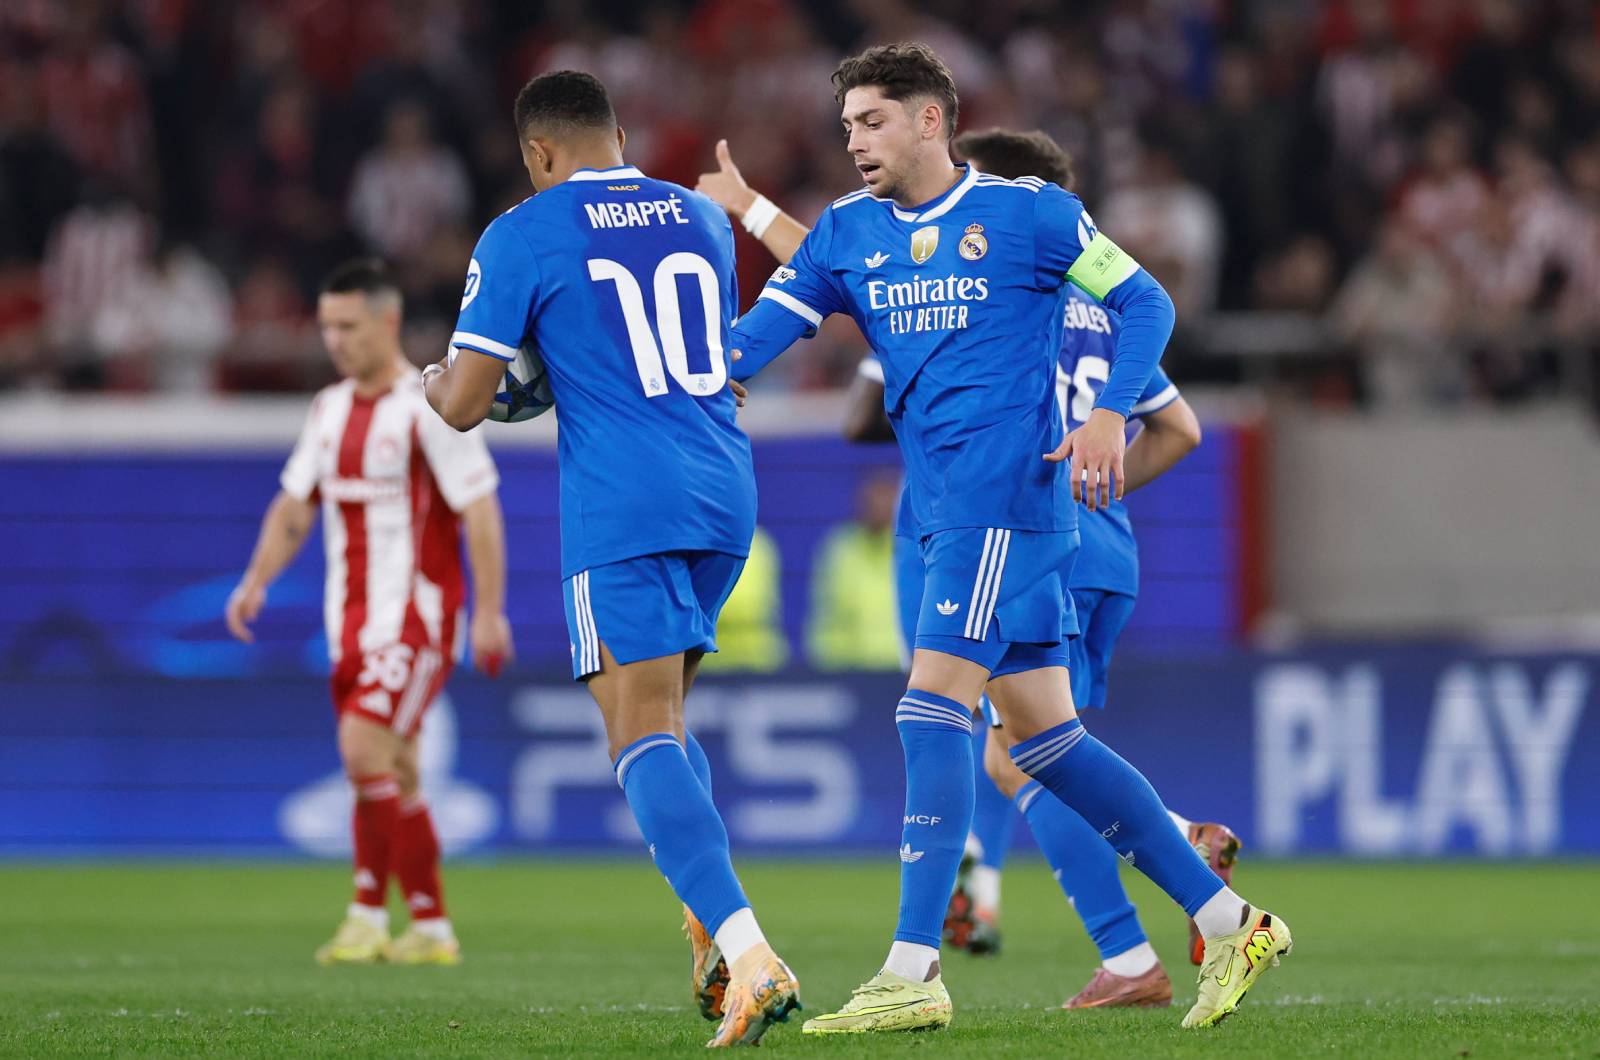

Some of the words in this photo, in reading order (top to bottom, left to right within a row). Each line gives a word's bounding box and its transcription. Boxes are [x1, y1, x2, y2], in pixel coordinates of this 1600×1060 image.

[584, 193, 689, 229] MBAPPÉ
[867, 272, 989, 310] Emirates
[587, 252, 727, 398] 10
[890, 309, 913, 334] FLY
[915, 305, 969, 332] BETTER
[1255, 664, 1590, 854] PLAY
[903, 814, 942, 826] MCF
[1102, 820, 1120, 838] CF
